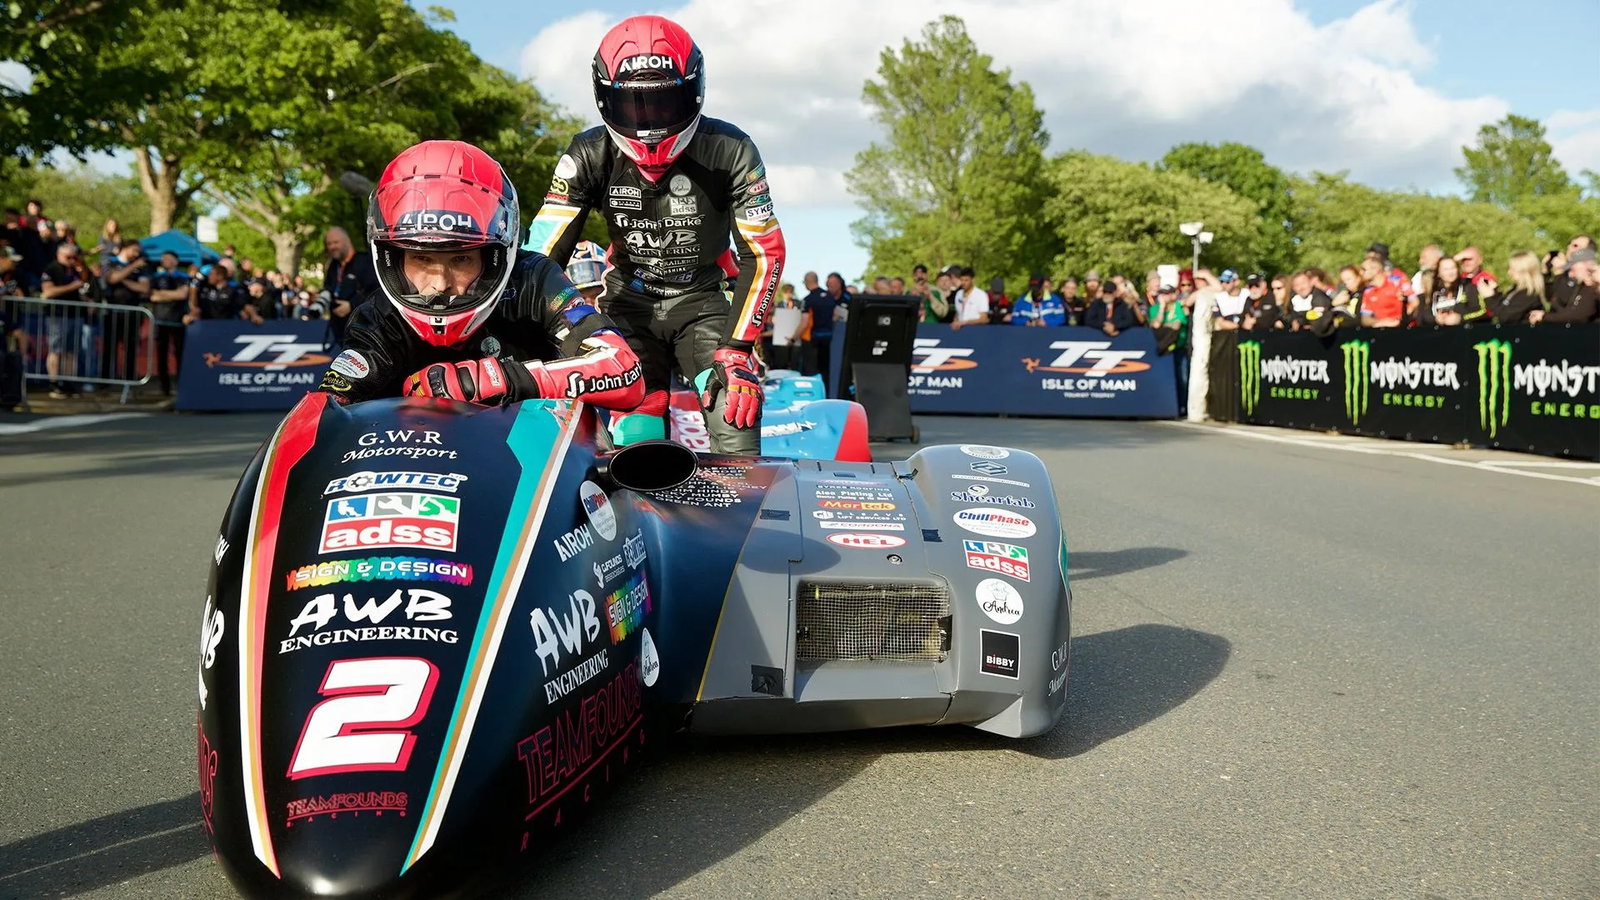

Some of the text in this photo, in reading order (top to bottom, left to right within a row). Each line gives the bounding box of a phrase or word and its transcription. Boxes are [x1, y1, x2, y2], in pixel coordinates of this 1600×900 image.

[619, 55, 673, 73] AIROH
[612, 188, 640, 196] AIROH
[672, 204, 697, 214] adss
[747, 202, 774, 217] SYKES
[664, 218, 702, 228] Darke
[624, 231, 698, 249] AWB
[230, 334, 324, 371] TT
[1048, 340, 1147, 378] TT
[1260, 355, 1331, 384] MONSTER
[1370, 355, 1461, 391] MONSTER
[218, 373, 315, 385] ISLE OF MAN
[590, 375, 622, 393] John
[927, 376, 963, 389] MAN
[1041, 378, 1137, 392] ISLE OF MAN
[1270, 386, 1321, 400] ENERGY
[1382, 392, 1446, 409] ENERGY
[357, 429, 443, 447] G.W.R
[341, 445, 458, 464] Motorsport
[823, 501, 891, 510] Martek
[951, 491, 1036, 508] Shearfab
[325, 520, 453, 549] adss
[553, 523, 595, 563] AIROH
[842, 536, 897, 546] HEL
[295, 560, 467, 582] SIGN & DESIGN
[969, 555, 1028, 578] adss
[289, 588, 453, 638] AWB
[279, 626, 460, 655] ENGINEERING
[529, 589, 601, 678] AWB
[543, 648, 610, 705] ENGINEERING
[286, 656, 440, 781] 2
[286, 791, 408, 819] TEAMFOUNDS
